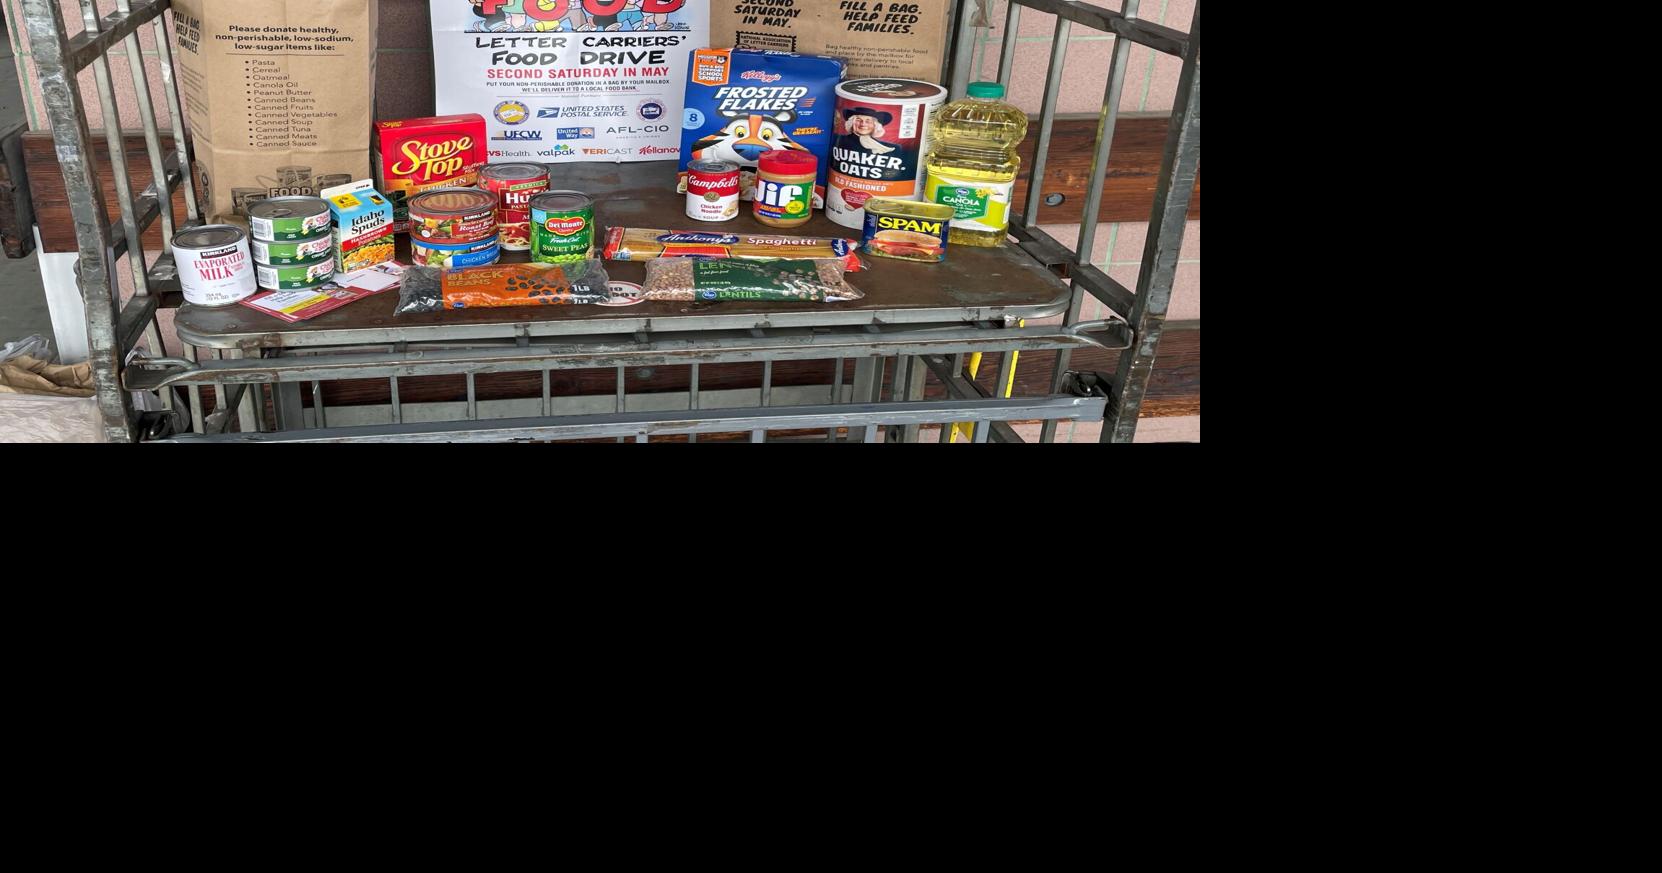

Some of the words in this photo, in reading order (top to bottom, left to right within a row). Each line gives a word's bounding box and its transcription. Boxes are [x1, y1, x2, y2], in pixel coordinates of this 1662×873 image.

[734, 5, 801, 18] SATURDAY
[840, 1, 867, 11] FILL
[873, 3, 883, 12] A
[889, 3, 922, 15] BAG.
[174, 11, 184, 24] FILL
[743, 16, 758, 24] IN
[763, 17, 791, 28] MAY.
[844, 11, 878, 22] HELP
[884, 14, 919, 24] FEED
[176, 24, 188, 37] HELP
[189, 29, 200, 43] FEED
[229, 25, 261, 33] Please
[263, 26, 298, 34] donate
[300, 26, 339, 35] healthy,
[847, 22, 915, 35] FAMILIES.
[215, 34, 292, 43] non-perishable,
[294, 35, 354, 43] low-sodium,
[476, 37, 567, 49] LETTER
[582, 36, 687, 48] CARRIERS'
[235, 43, 284, 52] low-sugar
[839, 44, 862, 52] healthy
[492, 51, 558, 66] FOOD
[580, 50, 666, 65] DRIVE
[488, 68, 544, 79] SECOND
[548, 68, 620, 79] SATURDAY
[624, 68, 637, 77] IN
[641, 68, 669, 77] MAY
[741, 70, 782, 82] Kellogg's
[714, 86, 808, 99] FROSTED
[719, 99, 798, 111] FLAKES
[291, 119, 313, 127] Soup
[689, 114, 698, 122] 8
[504, 130, 541, 138] UFCW
[606, 125, 669, 134] AFL-CIO
[392, 136, 474, 175] Stove
[537, 148, 575, 158] valpak
[423, 156, 463, 181] Top
[840, 162, 882, 179] OATS
[270, 187, 313, 198] FOOD
[845, 181, 887, 193] FASHIONED
[755, 180, 803, 207] Jif
[942, 196, 980, 206] CANOLA
[351, 209, 385, 226] Idaho
[464, 210, 490, 221] KIRKLAND
[352, 219, 385, 236] Spuds
[459, 223, 482, 232] Roast
[878, 216, 942, 235] SPAM
[542, 244, 568, 252] SWEET
[570, 243, 588, 252] PEAS
[747, 237, 817, 246] Spaghetti
[202, 247, 237, 257] KIRKLAND
[193, 252, 244, 269] EVAPORATED
[462, 254, 486, 263] CHICKEN
[200, 266, 234, 281] MILK
[448, 270, 504, 280] BLACK
[448, 279, 491, 287] BEANS
[719, 291, 762, 299] LENTILS
